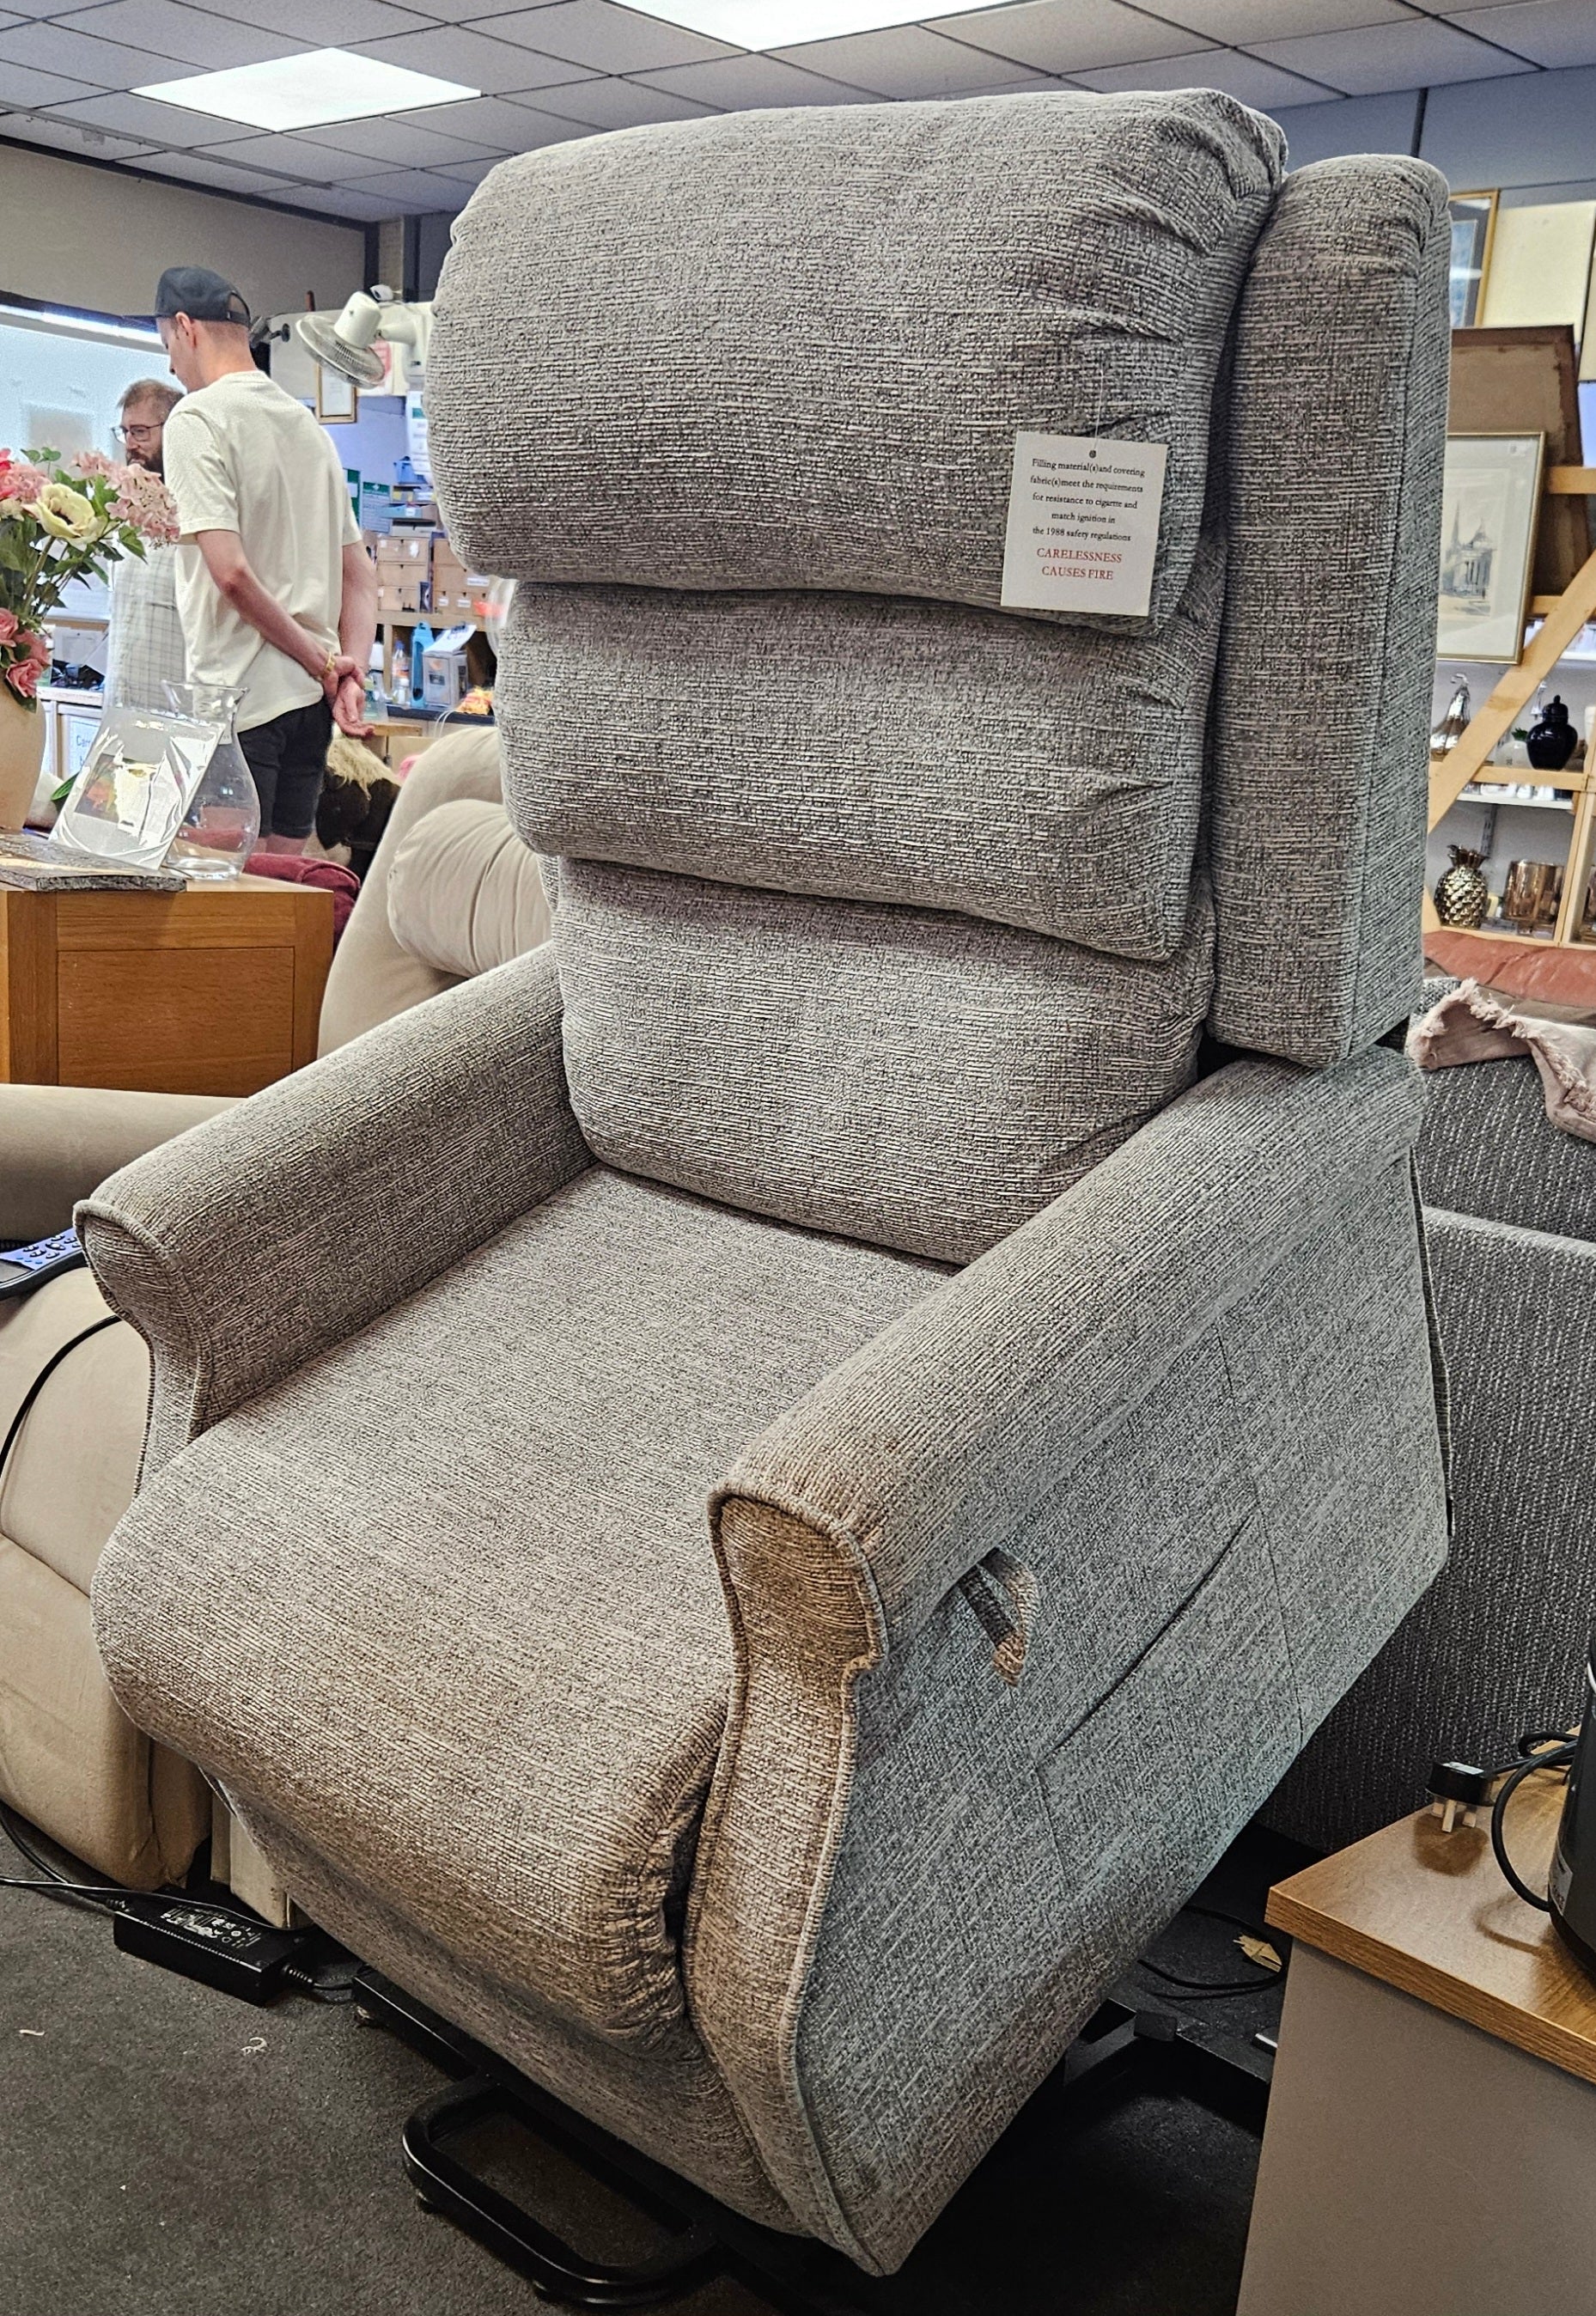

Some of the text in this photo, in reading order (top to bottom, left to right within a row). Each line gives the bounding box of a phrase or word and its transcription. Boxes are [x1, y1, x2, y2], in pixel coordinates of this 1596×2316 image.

[1032, 458, 1057, 471] Filling
[1113, 467, 1146, 478] covering
[1082, 479, 1094, 489] the
[1095, 483, 1143, 493] requirements
[1033, 492, 1044, 502] for
[1045, 495, 1084, 505] resistance
[1124, 501, 1138, 509] and
[1051, 512, 1116, 524] match ignition in
[1033, 526, 1131, 542] the 1988 safety regulations
[1036, 547, 1123, 564] CARELESSNESS
[1041, 566, 1114, 581] CAUSES FIRE
